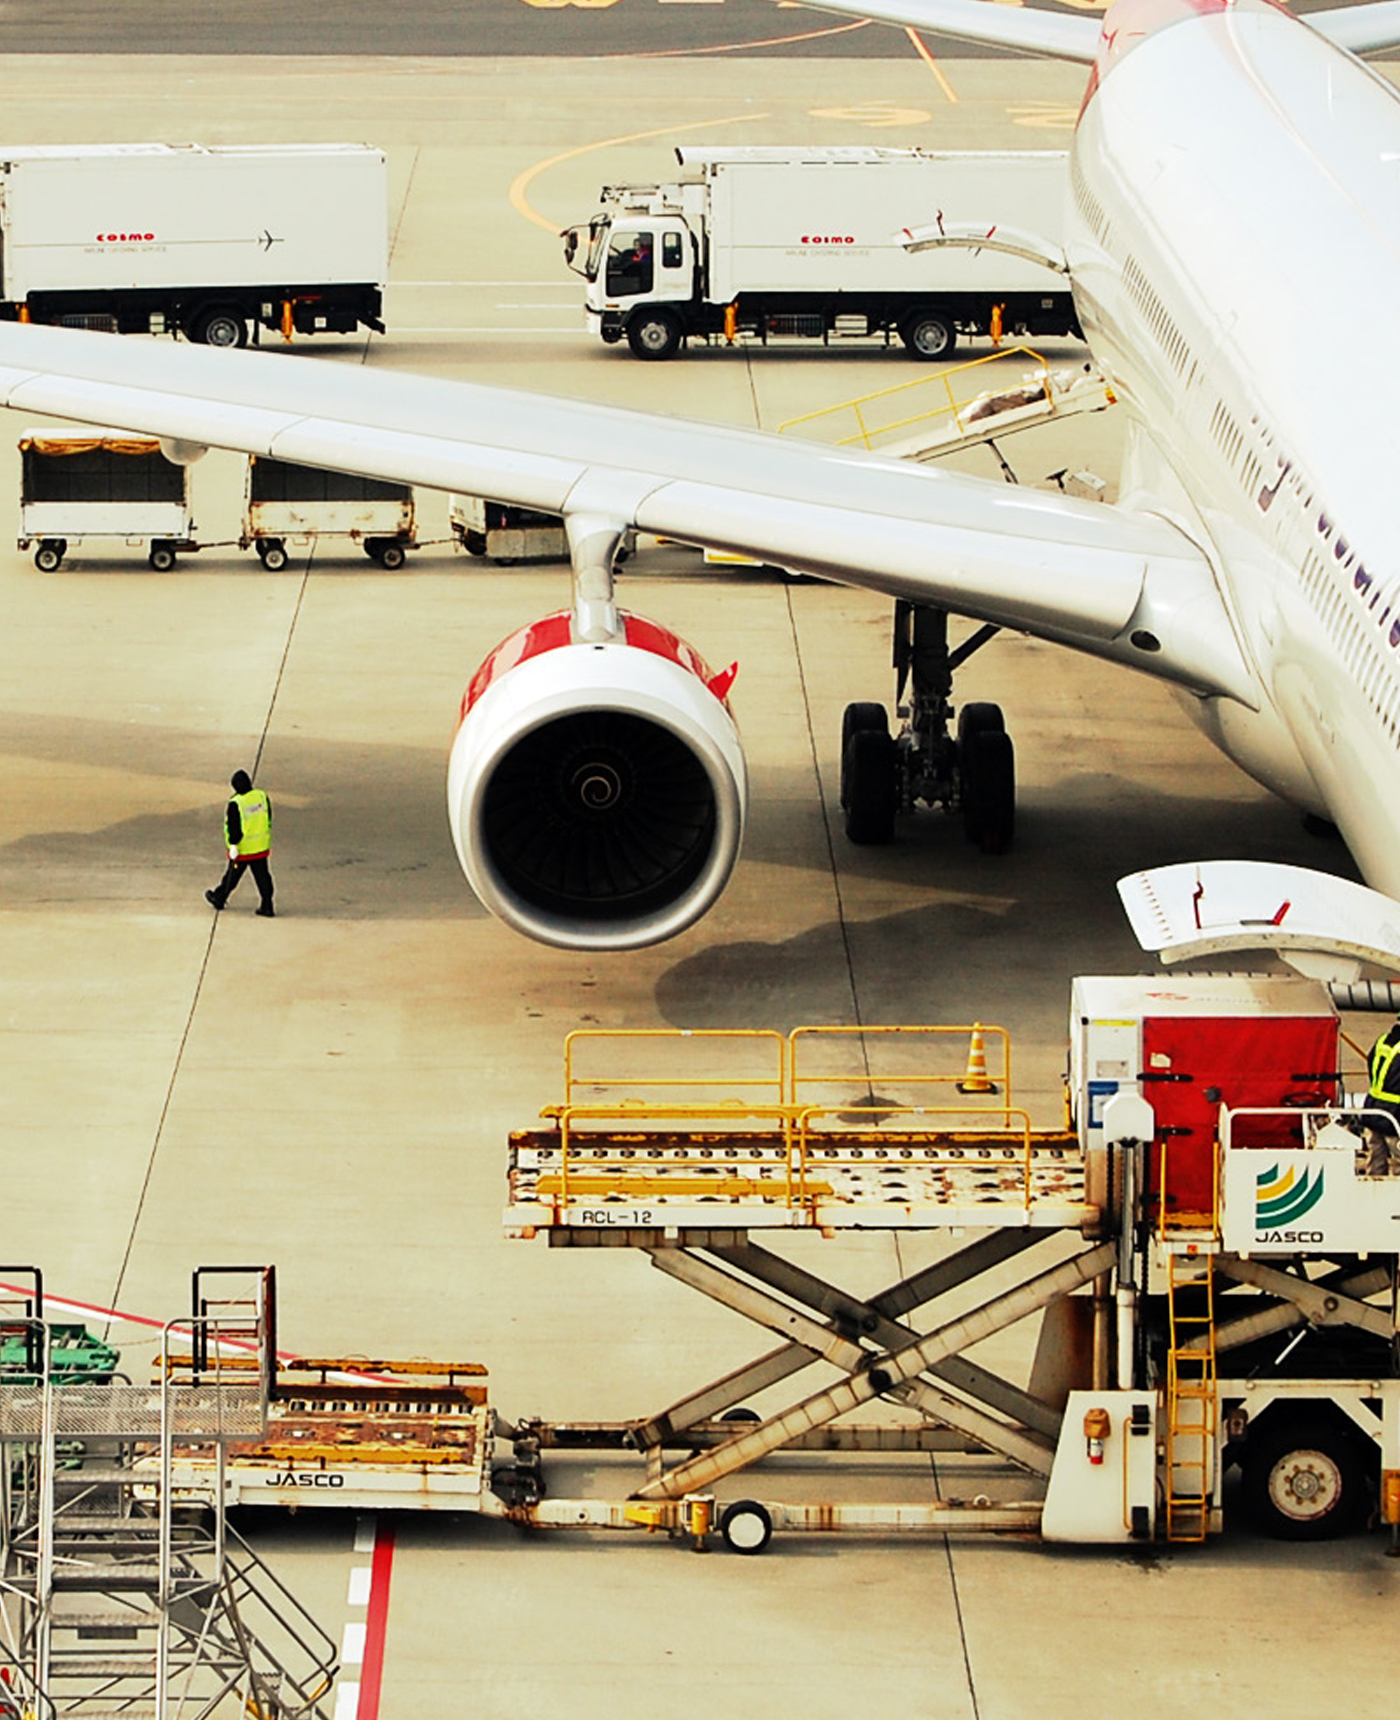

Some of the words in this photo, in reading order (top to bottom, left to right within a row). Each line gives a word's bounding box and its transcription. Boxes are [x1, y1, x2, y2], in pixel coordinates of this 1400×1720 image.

[582, 1210, 652, 1224] RCL-12
[1255, 1231, 1324, 1243] JASCO
[266, 1473, 344, 1487] JASCO
